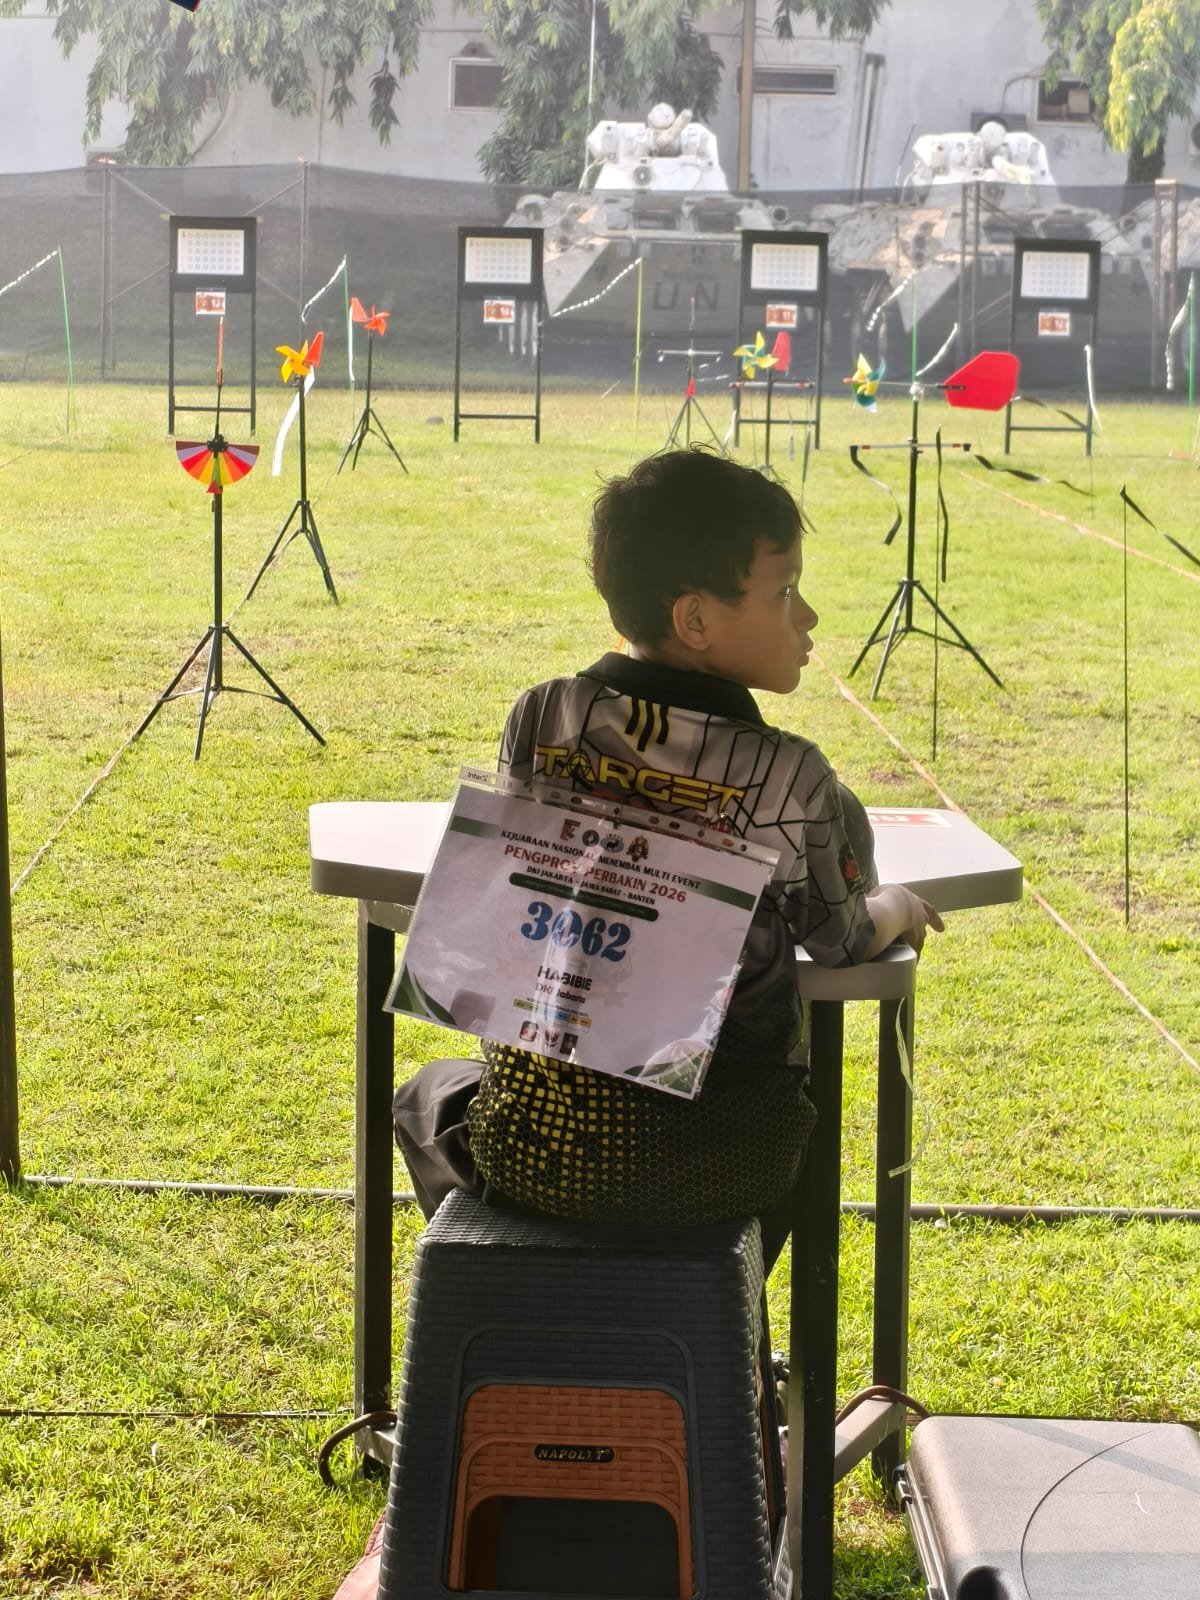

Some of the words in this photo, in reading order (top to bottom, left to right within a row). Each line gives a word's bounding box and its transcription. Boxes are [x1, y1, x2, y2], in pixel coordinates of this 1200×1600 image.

[535, 743, 745, 815] TARGET
[501, 830, 549, 848] KEJUARAAN
[551, 842, 597, 861] NASIONAL
[598, 855, 641, 873] MENEMBAK
[643, 865, 671, 881] MULTI
[671, 874, 701, 890] EVENT
[584, 866, 647, 892] PERBAKIN
[649, 882, 688, 903] 2026
[540, 867, 574, 885] JAKARTA
[627, 891, 656, 905] BANTEN
[520, 901, 631, 962] 3062
[537, 965, 593, 991] HABIBIE
